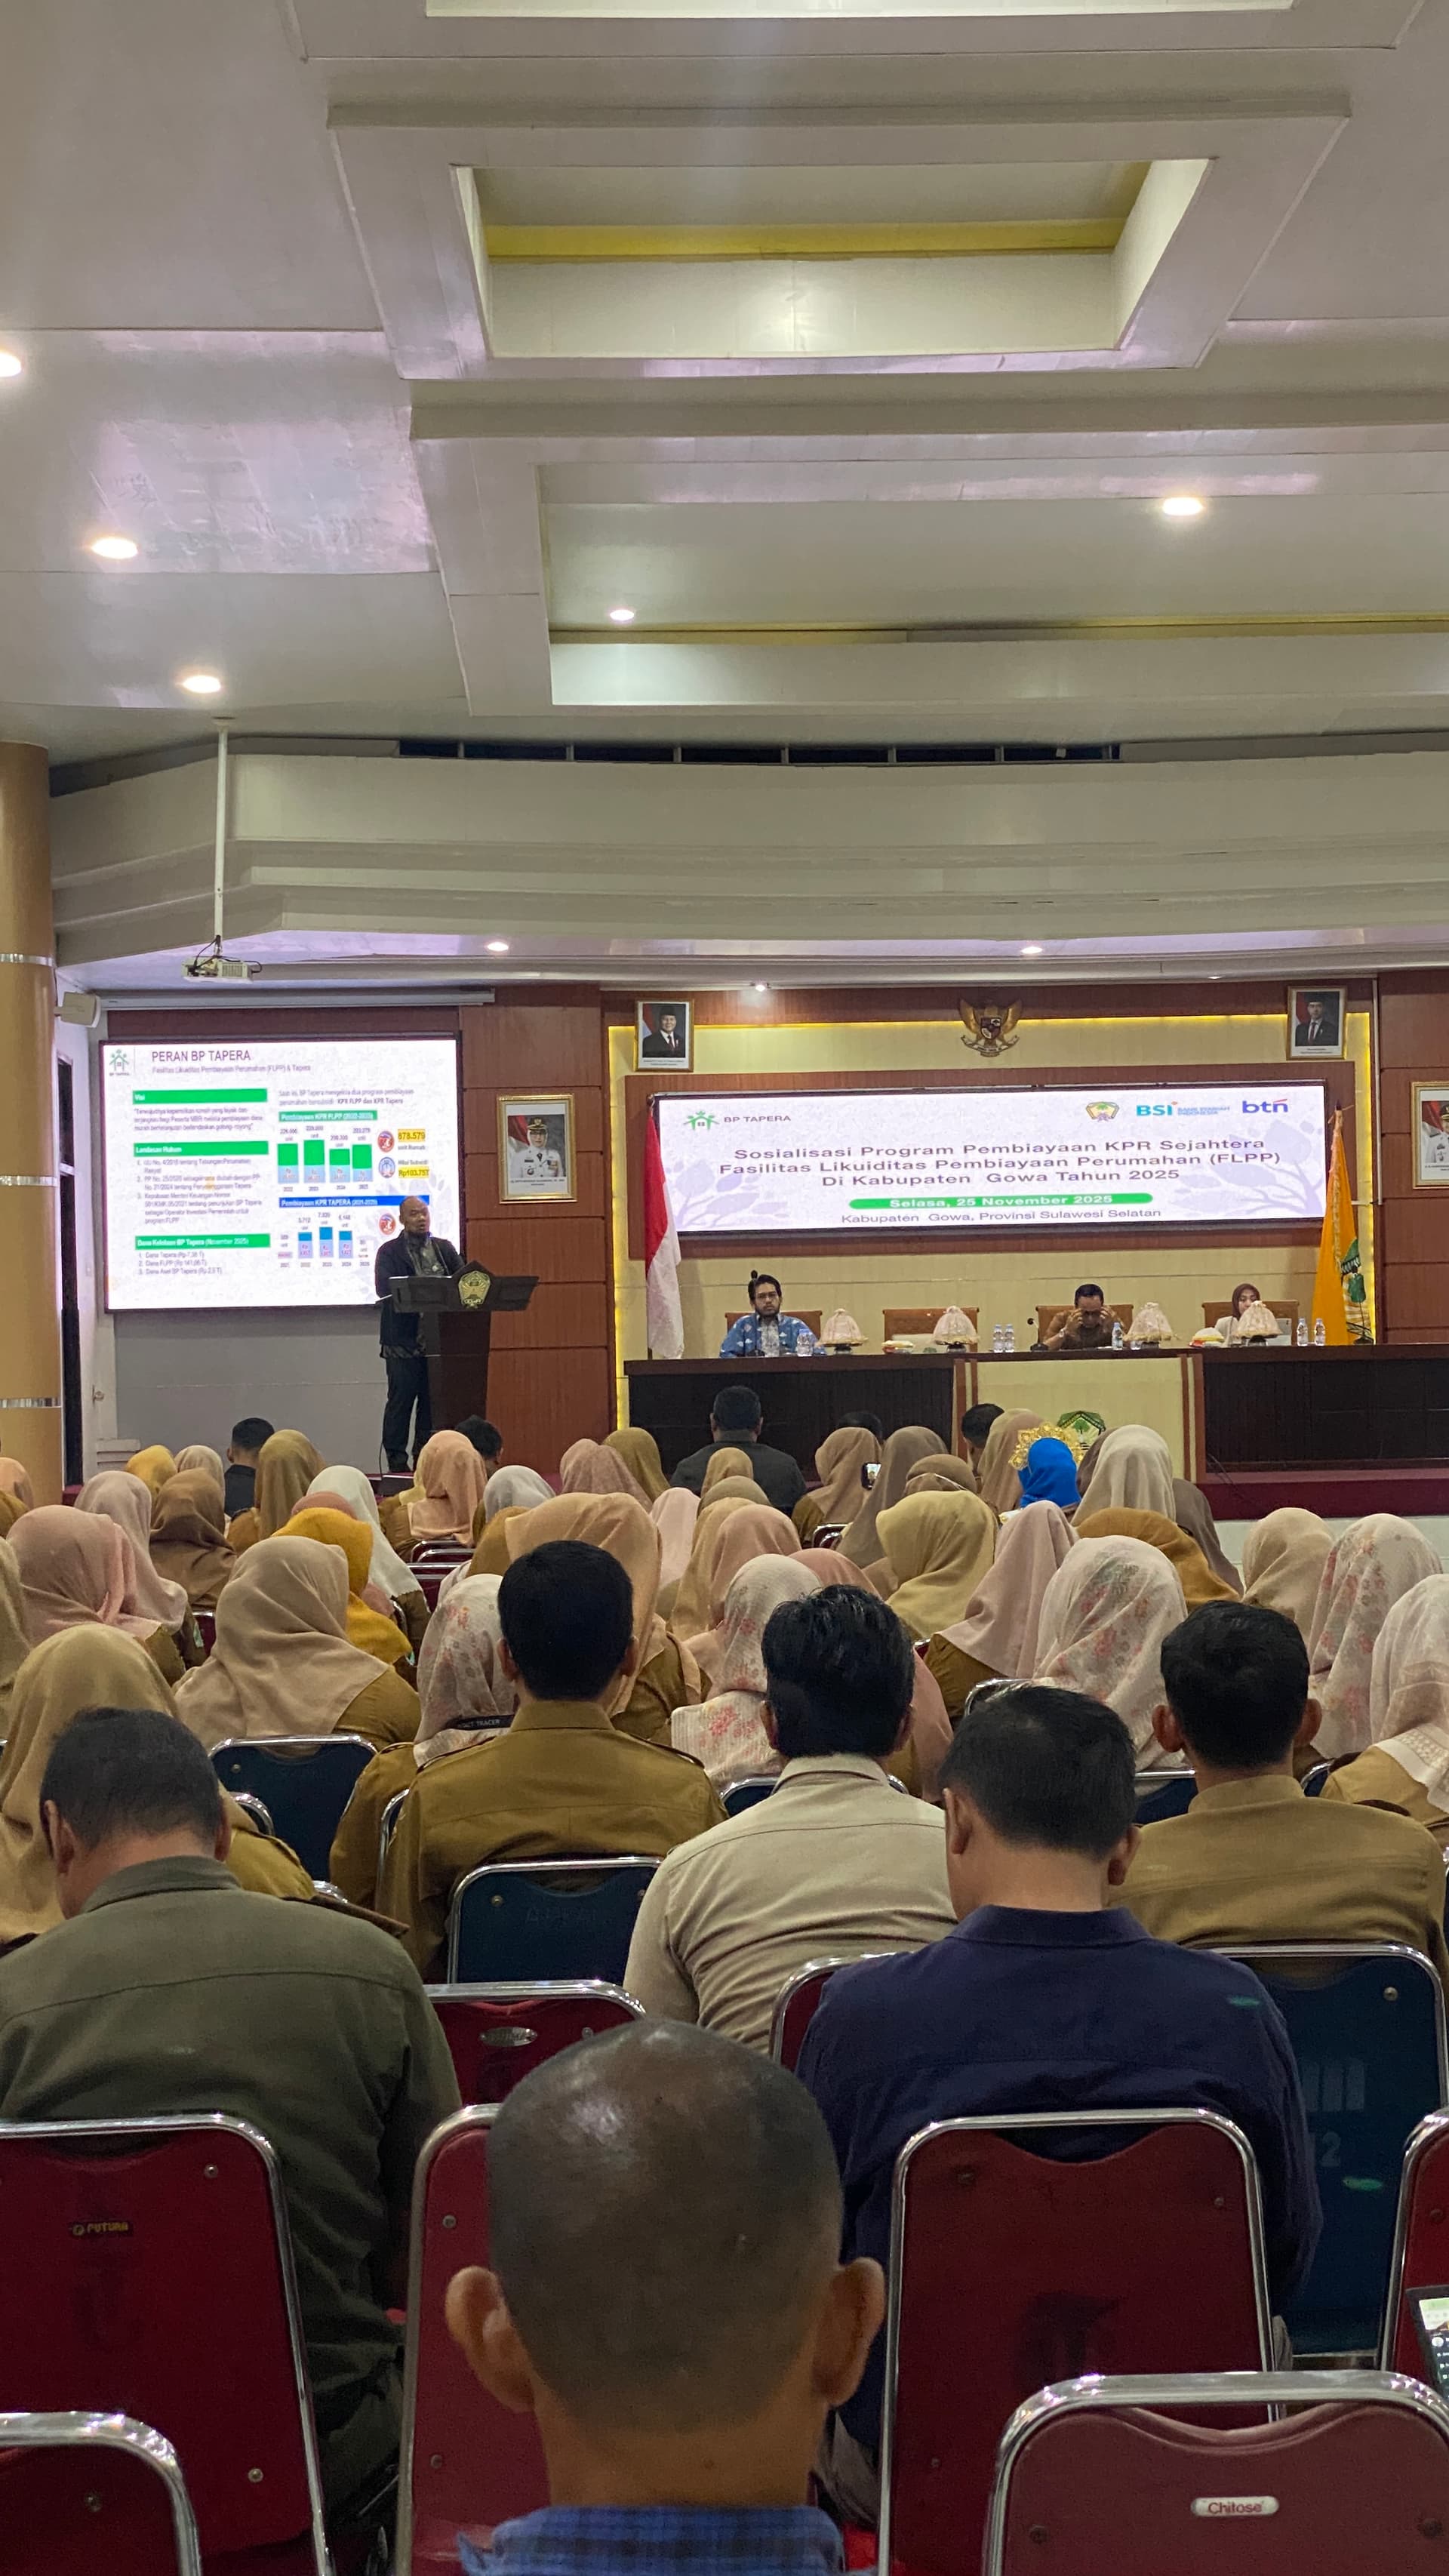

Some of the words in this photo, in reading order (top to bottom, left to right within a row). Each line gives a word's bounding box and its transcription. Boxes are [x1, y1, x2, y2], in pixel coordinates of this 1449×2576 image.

[152, 1051, 188, 1062] PERAN
[191, 1051, 205, 1061] BP
[208, 1050, 251, 1061] TAPERA
[1136, 1102, 1177, 1116] BSI
[1241, 1099, 1288, 1113] btn
[734, 1147, 852, 1159] Sosialisasi
[860, 1146, 954, 1159] Program
[964, 1143, 1097, 1156] Pembiayaan
[1105, 1141, 1151, 1151] KPR
[1160, 1140, 1265, 1153] Sejahtera
[719, 1163, 811, 1174] Fasilitas
[820, 1161, 927, 1172] Likuiditas
[936, 1157, 1069, 1171] Pembiayaan
[1077, 1155, 1201, 1167] Perumahan
[1210, 1153, 1281, 1166] (FLPP)
[823, 1176, 844, 1186] Di
[853, 1174, 971, 1188] Kabupaten
[986, 1173, 1048, 1183] Gowa
[1057, 1171, 1121, 1181] Tahun
[1129, 1169, 1180, 1180] 2025
[889, 1199, 951, 1209] Selasa,
[956, 1198, 976, 1207] 25
[982, 1196, 1068, 1206] November
[1073, 1195, 1113, 1204] 2025
[841, 1214, 919, 1225] Kabupaten
[928, 1212, 974, 1223] Gowa,
[980, 1211, 1035, 1220] Provinsi
[1040, 1209, 1103, 1219] Sulawesi
[1107, 1208, 1161, 1218] Selatan
[1208, 2501, 1263, 2514] Chitose
